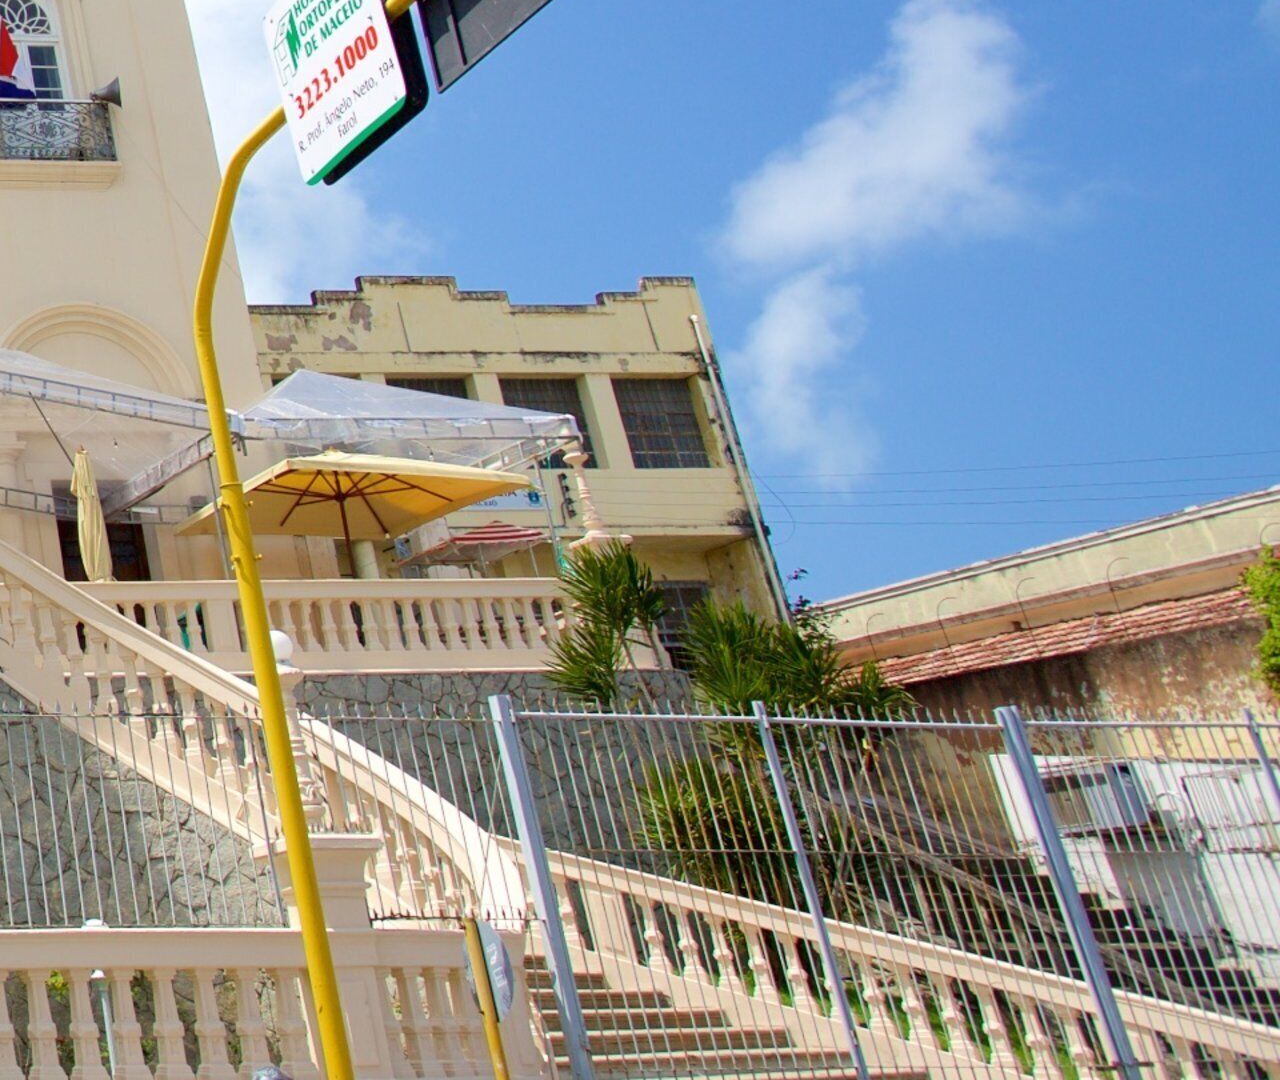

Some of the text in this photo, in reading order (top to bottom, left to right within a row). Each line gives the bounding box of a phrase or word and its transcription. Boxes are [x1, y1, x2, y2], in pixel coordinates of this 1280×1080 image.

[295, 25, 378, 119] 3223.1000
[304, 34, 319, 58] DE
[298, 140, 307, 154] R.
[306, 121, 325, 145] Prof.
[379, 57, 395, 79] 194
[337, 111, 359, 138] Farol
